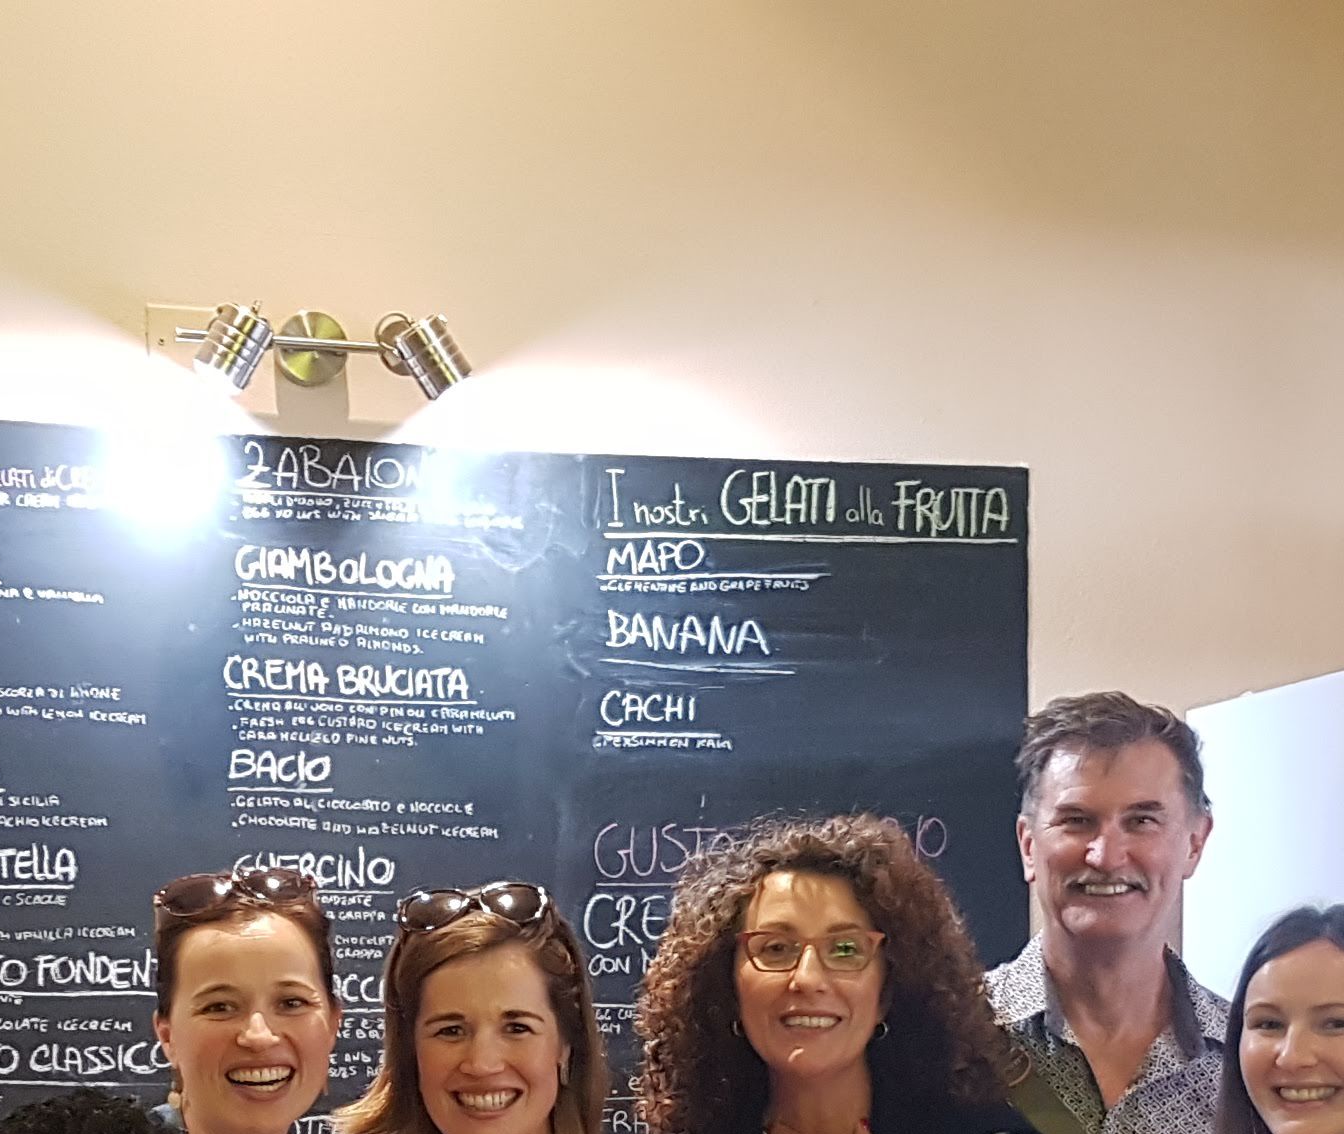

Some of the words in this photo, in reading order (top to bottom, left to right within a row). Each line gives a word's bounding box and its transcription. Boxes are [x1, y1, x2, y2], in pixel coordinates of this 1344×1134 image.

[605, 468, 625, 527] I
[633, 483, 708, 526] nostri
[720, 469, 837, 526] GELATI
[846, 486, 885, 526] alla
[891, 480, 1010, 538] FRUTTA
[234, 545, 455, 593] GIAMBOLOGNA
[606, 539, 705, 575] MAPO
[237, 589, 315, 605] NOCCIOLA
[689, 581, 717, 592] AND
[242, 618, 316, 632] HAZELNUT
[321, 622, 353, 637] AND
[244, 634, 277, 645] WITH
[606, 610, 770, 655] BANANA
[223, 655, 330, 695] CREMA
[336, 664, 469, 700] BRUCIATA
[600, 690, 696, 726] CACHI
[240, 716, 284, 728] FRESH
[318, 715, 377, 729] CUSTARD
[452, 724, 484, 735] WITH
[228, 749, 331, 783] BACIO
[8, 795, 60, 807] SICILIA
[235, 796, 290, 808] GELATO
[238, 813, 317, 831] CHOCOLATE
[322, 820, 352, 835] AND
[356, 823, 438, 837] HAZELNUT
[335, 934, 395, 946] CHOCOLAT
[29, 1040, 173, 1075] CLASSICO
